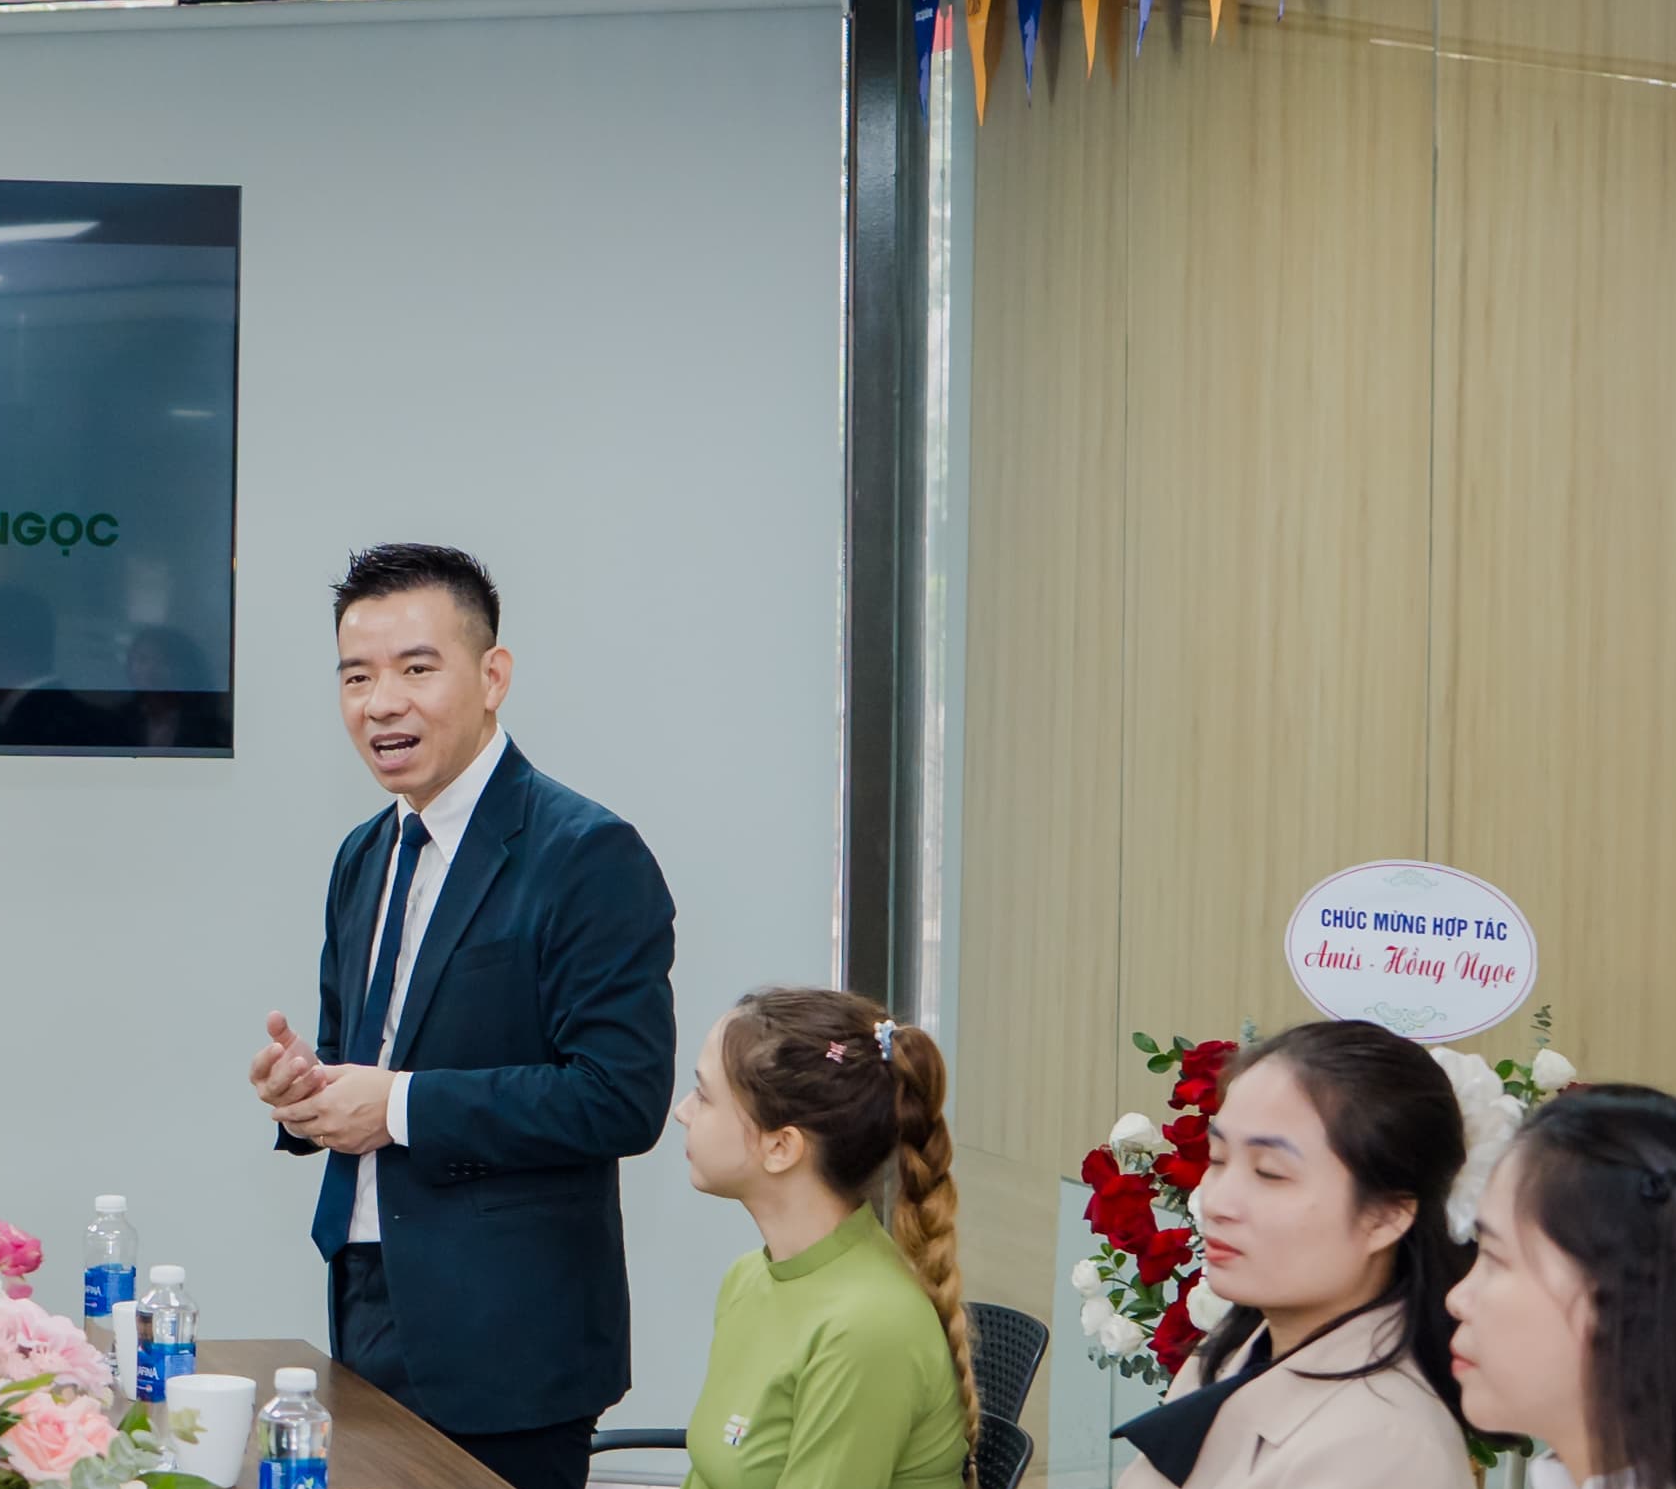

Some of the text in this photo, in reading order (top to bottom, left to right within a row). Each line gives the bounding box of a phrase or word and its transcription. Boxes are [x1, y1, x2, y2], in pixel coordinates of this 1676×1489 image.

[1320, 906, 1508, 941] CHÚC MỪNG HỢP TÁC
[1304, 939, 1363, 971] Amis
[1383, 944, 1447, 985] Hồng
[1454, 949, 1517, 990] Ngọc
